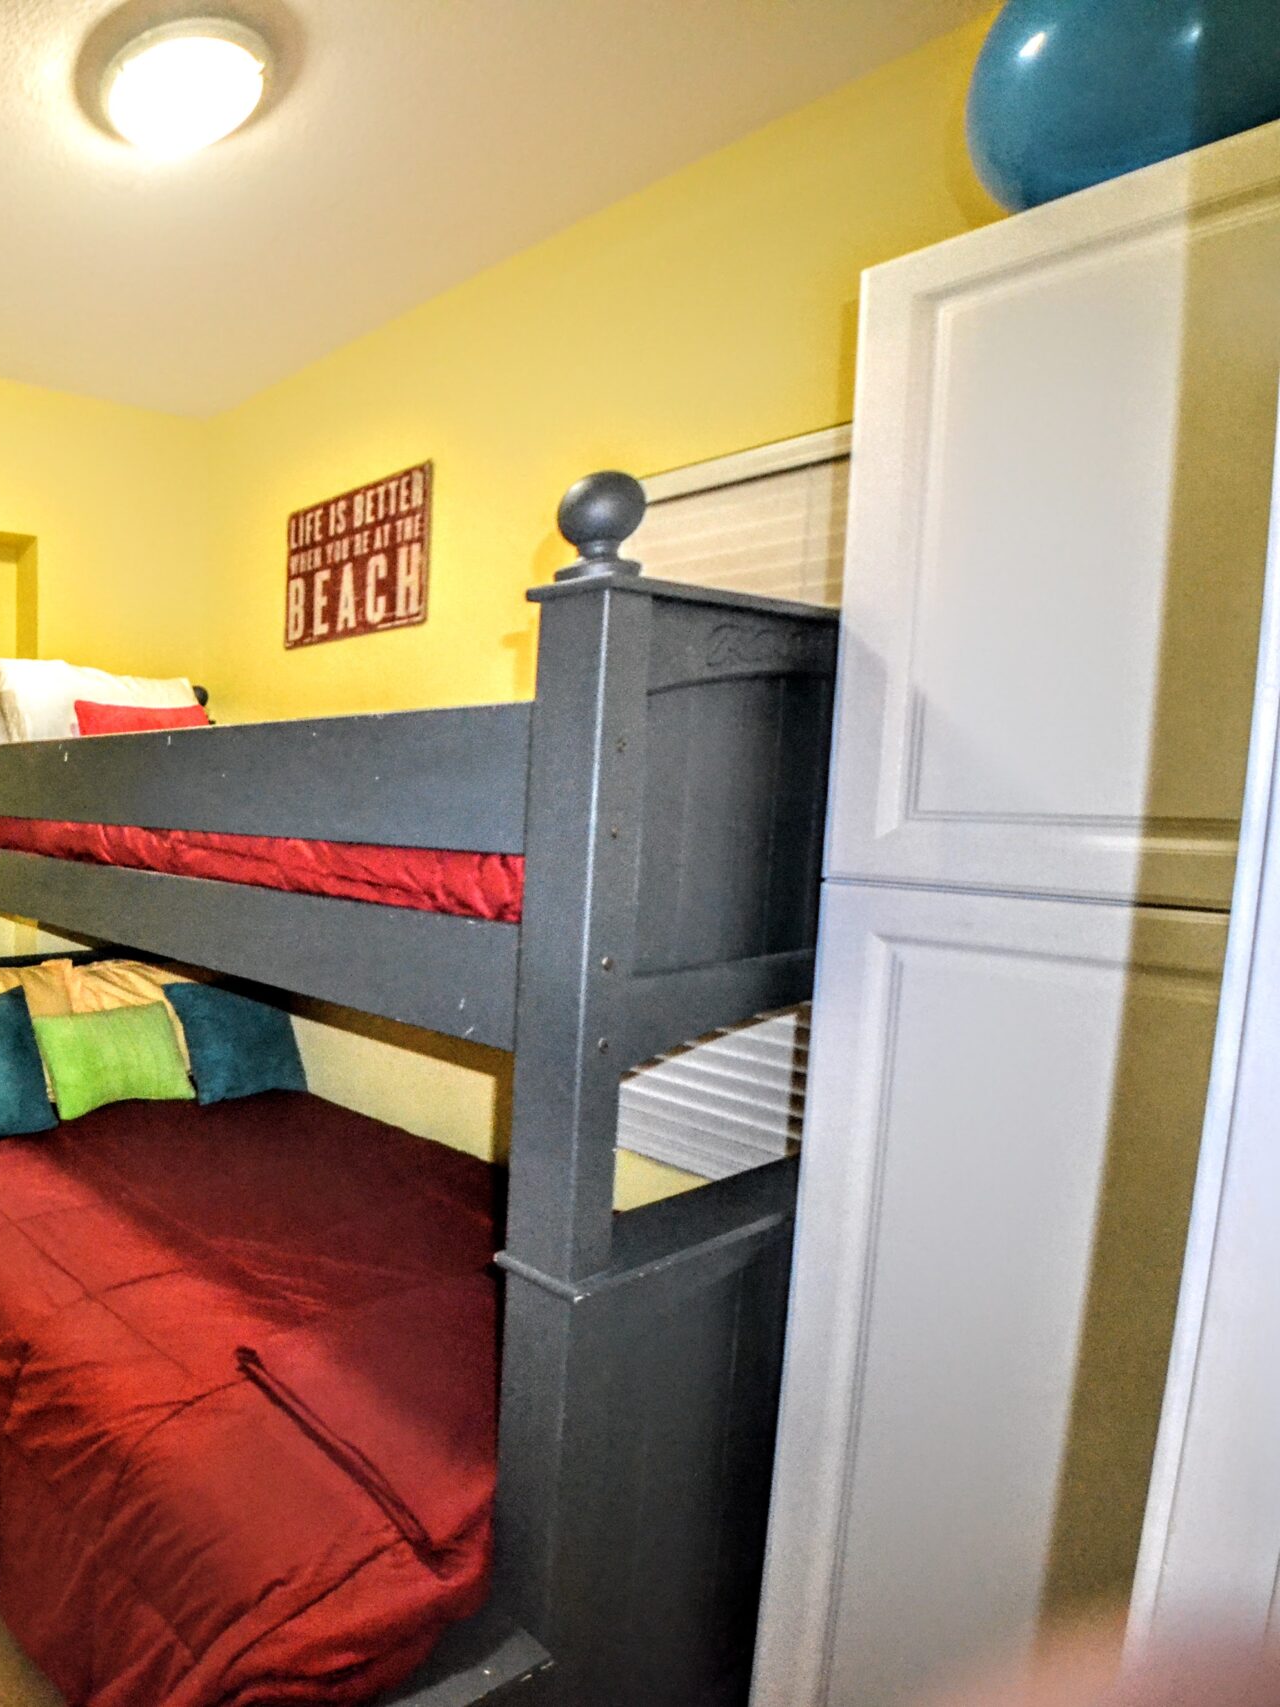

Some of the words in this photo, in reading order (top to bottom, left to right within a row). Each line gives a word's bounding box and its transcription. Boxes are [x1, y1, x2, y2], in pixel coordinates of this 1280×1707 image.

[290, 508, 324, 549] LIFE
[328, 500, 347, 537] IS
[353, 469, 424, 528] BETTER
[290, 547, 323, 577] WHEN
[373, 523, 391, 550] AT
[395, 514, 422, 544] THE
[287, 541, 422, 642] BEACH
